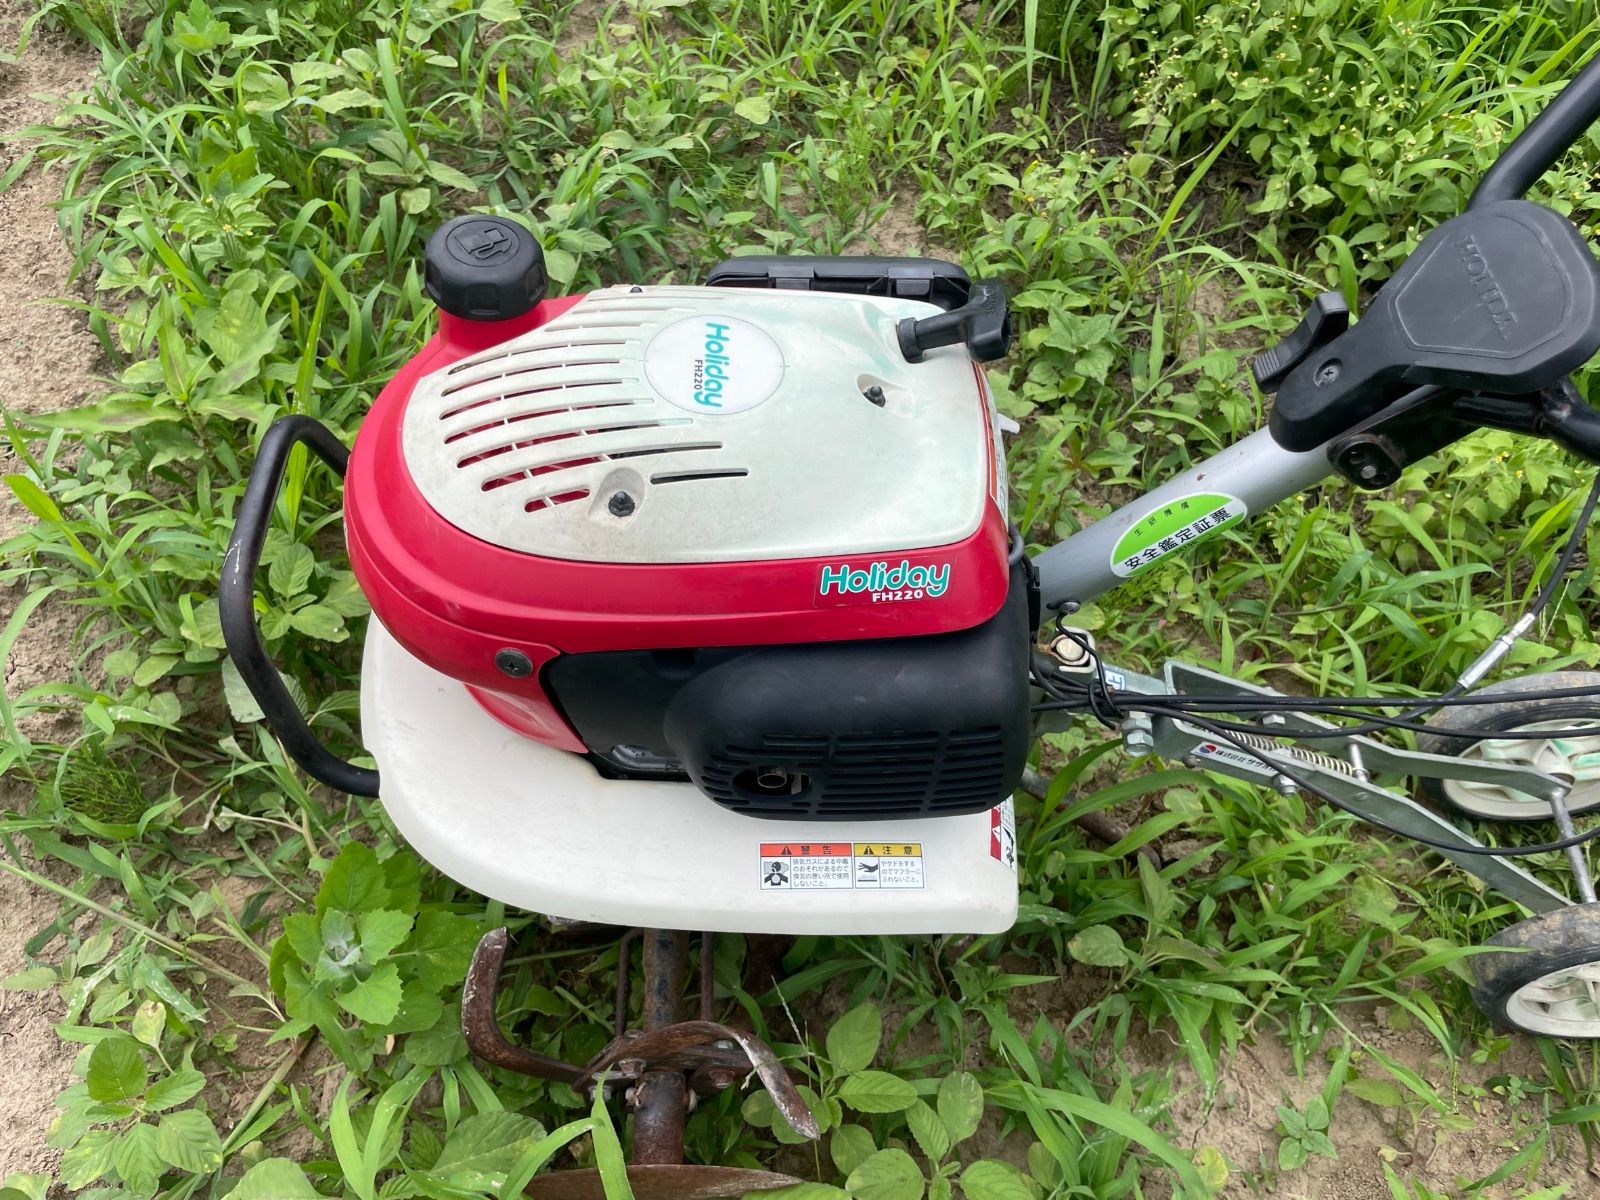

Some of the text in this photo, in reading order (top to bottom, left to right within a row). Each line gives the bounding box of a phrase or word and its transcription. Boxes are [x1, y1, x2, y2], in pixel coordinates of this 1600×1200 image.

[693, 322, 730, 408] Holiday
[693, 360, 703, 390] FH220
[1124, 508, 1231, 570] 安全鑑定証票
[820, 560, 950, 597] Holiday
[872, 590, 923, 602] FH220
